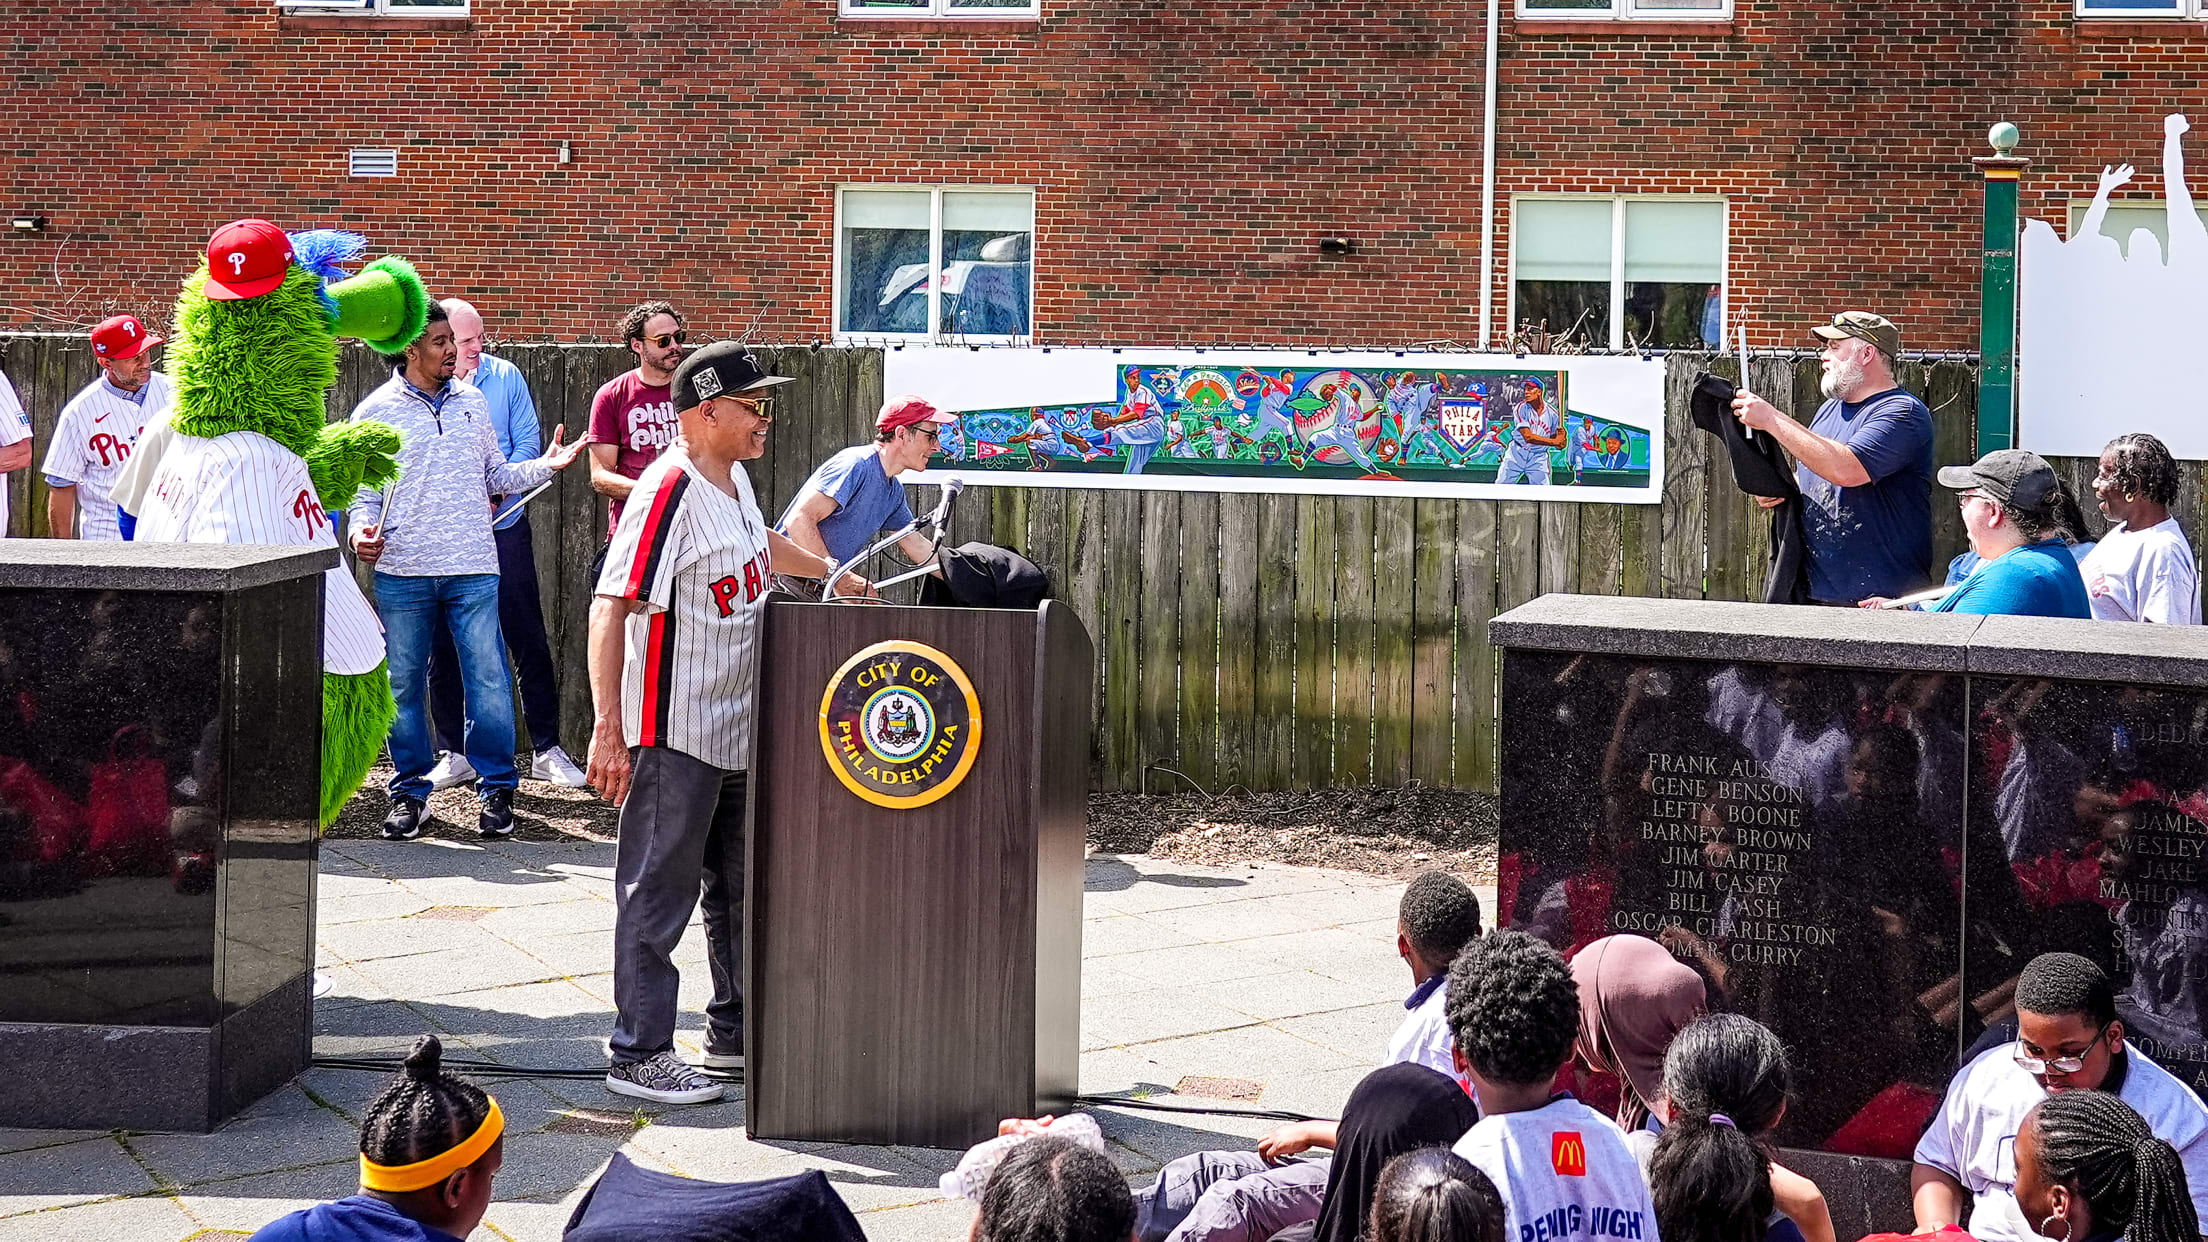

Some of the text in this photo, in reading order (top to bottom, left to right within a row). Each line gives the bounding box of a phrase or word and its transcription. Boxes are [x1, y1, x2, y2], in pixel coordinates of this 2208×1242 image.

[227, 252, 246, 275] P
[122, 321, 136, 337] P
[627, 401, 677, 434] phil
[1444, 405, 1480, 421] PHILA
[630, 423, 680, 452] phil
[1444, 424, 1482, 437] STARS
[856, 662, 940, 688] CITY OF
[837, 720, 959, 785] PHILADELPHIA
[1649, 752, 1772, 779] FRANK AUS
[1651, 776, 1804, 804] GENE BENSON
[1653, 800, 1801, 828] LEFTY BOONE
[1642, 821, 1812, 851] BARNEY BROWN
[2118, 833, 2207, 858] WESLEY
[1661, 847, 1789, 873] JIM CARTER
[2139, 859, 2198, 882] JAKE
[1666, 870, 1783, 896] JIM CASEY
[2099, 879, 2182, 902] MAHLO
[1669, 893, 1713, 913] BILL
[1614, 911, 1836, 946] OSCAR CHARLESTON
[1731, 944, 1803, 967] CURRY
[1590, 1207, 1645, 1240] NIGH
